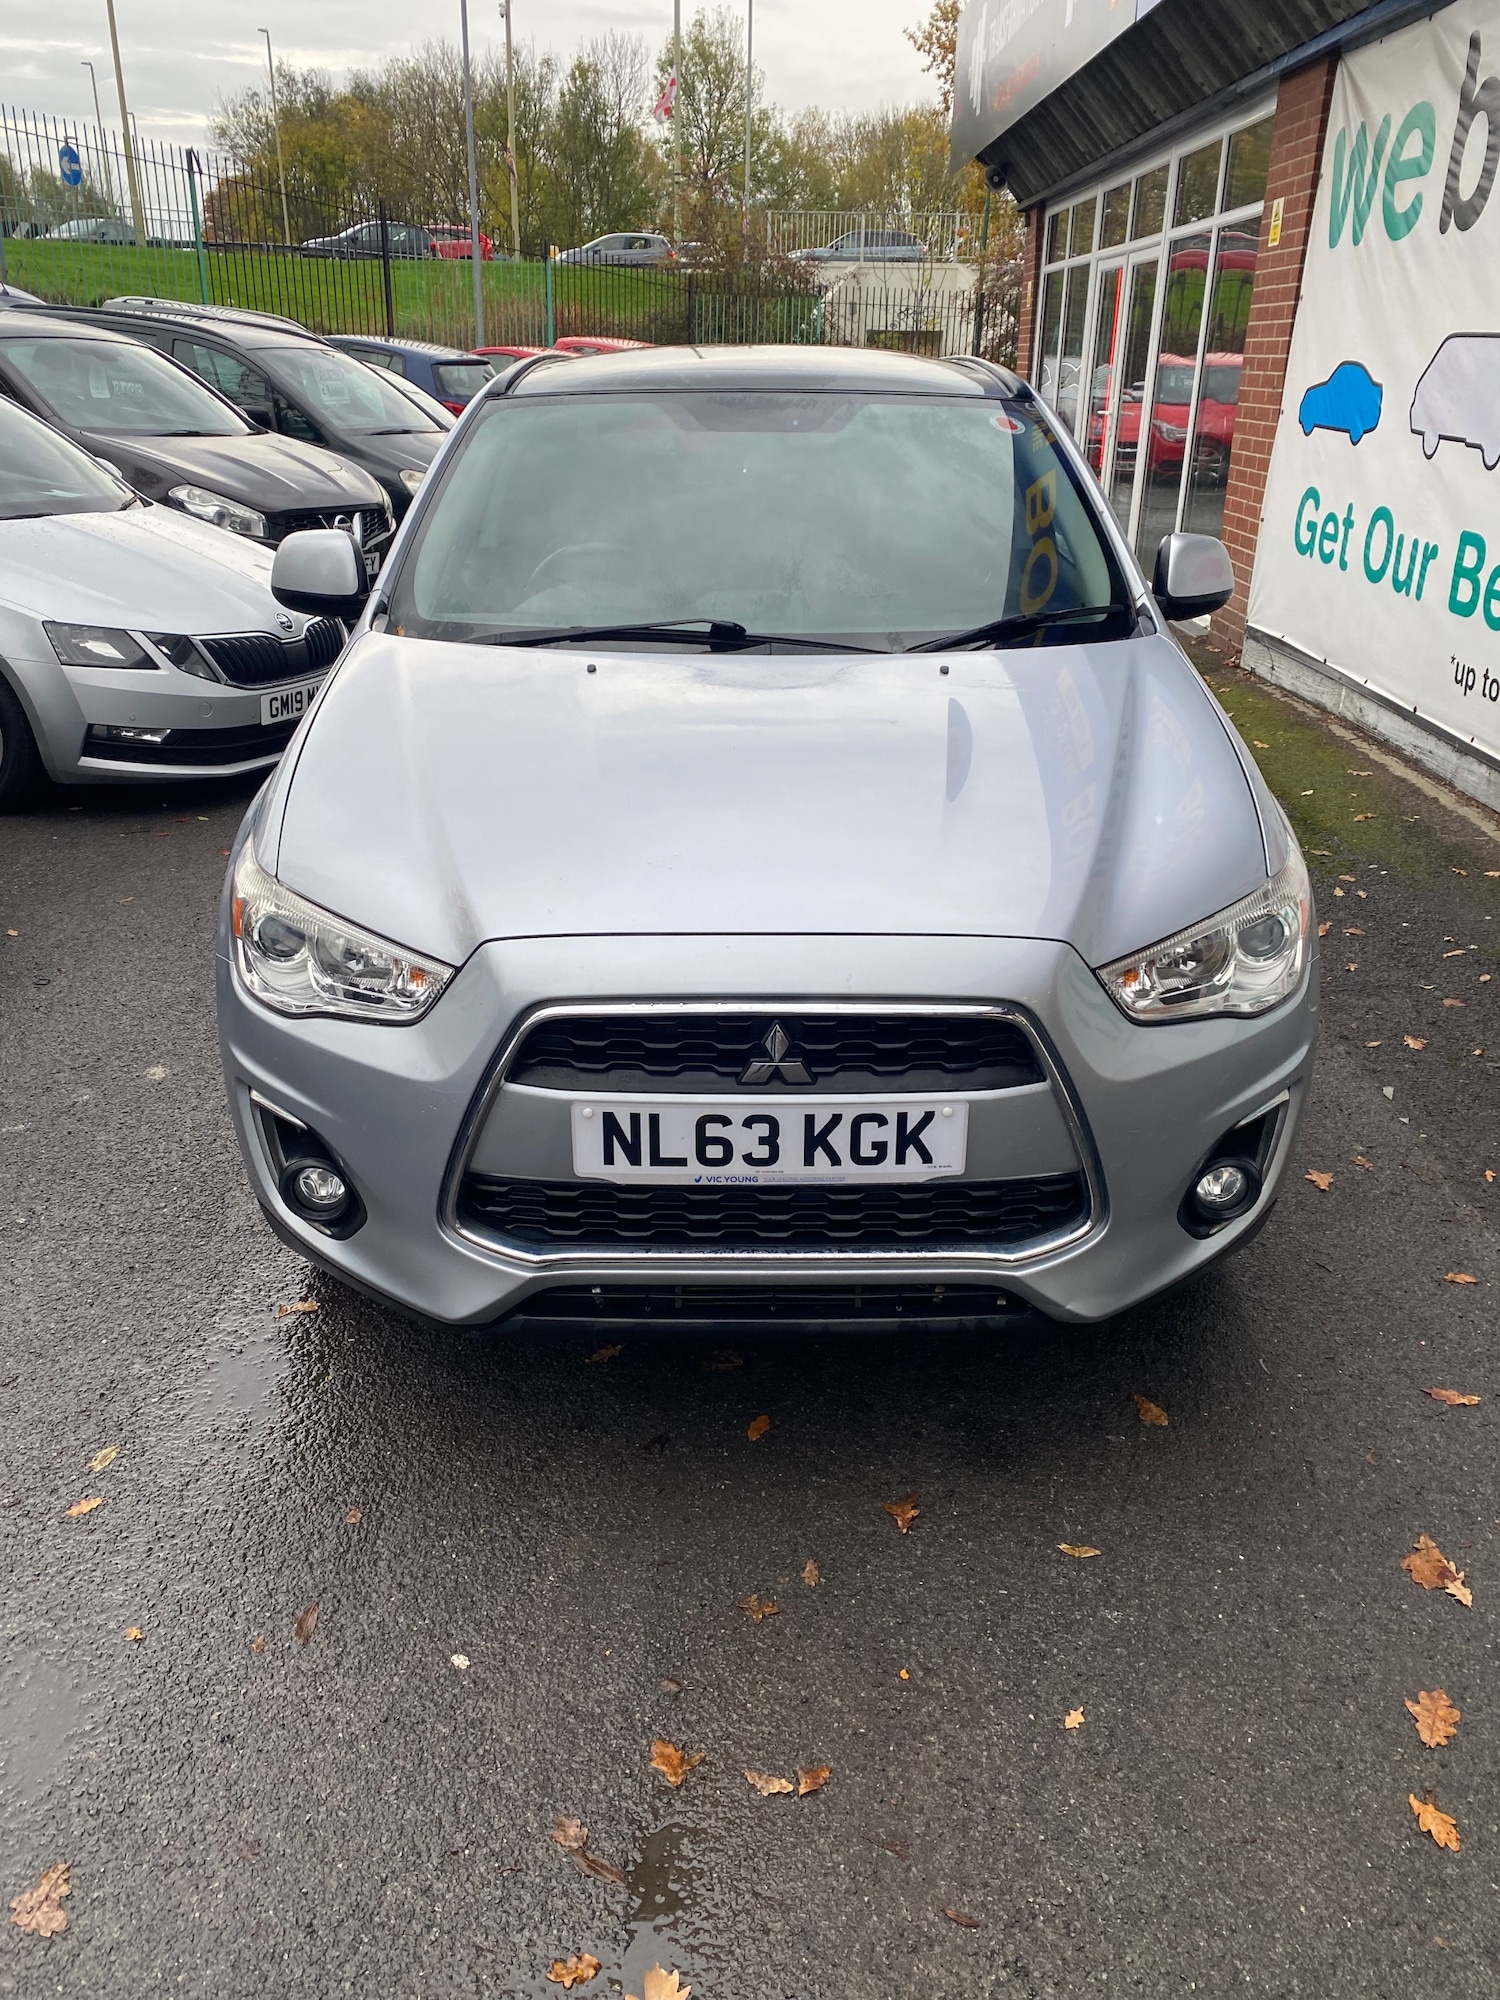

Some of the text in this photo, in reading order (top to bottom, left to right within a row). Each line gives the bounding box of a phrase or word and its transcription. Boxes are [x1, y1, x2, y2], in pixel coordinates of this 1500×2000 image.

[1294, 486, 1354, 572] Get
[1363, 505, 1439, 602] Our
[269, 685, 321, 719] GM19 M
[1482, 667, 1500, 702] to
[602, 1110, 936, 1168] NL63 KGK
[706, 1175, 722, 1183] VIC
[724, 1175, 759, 1183] YOUNG
